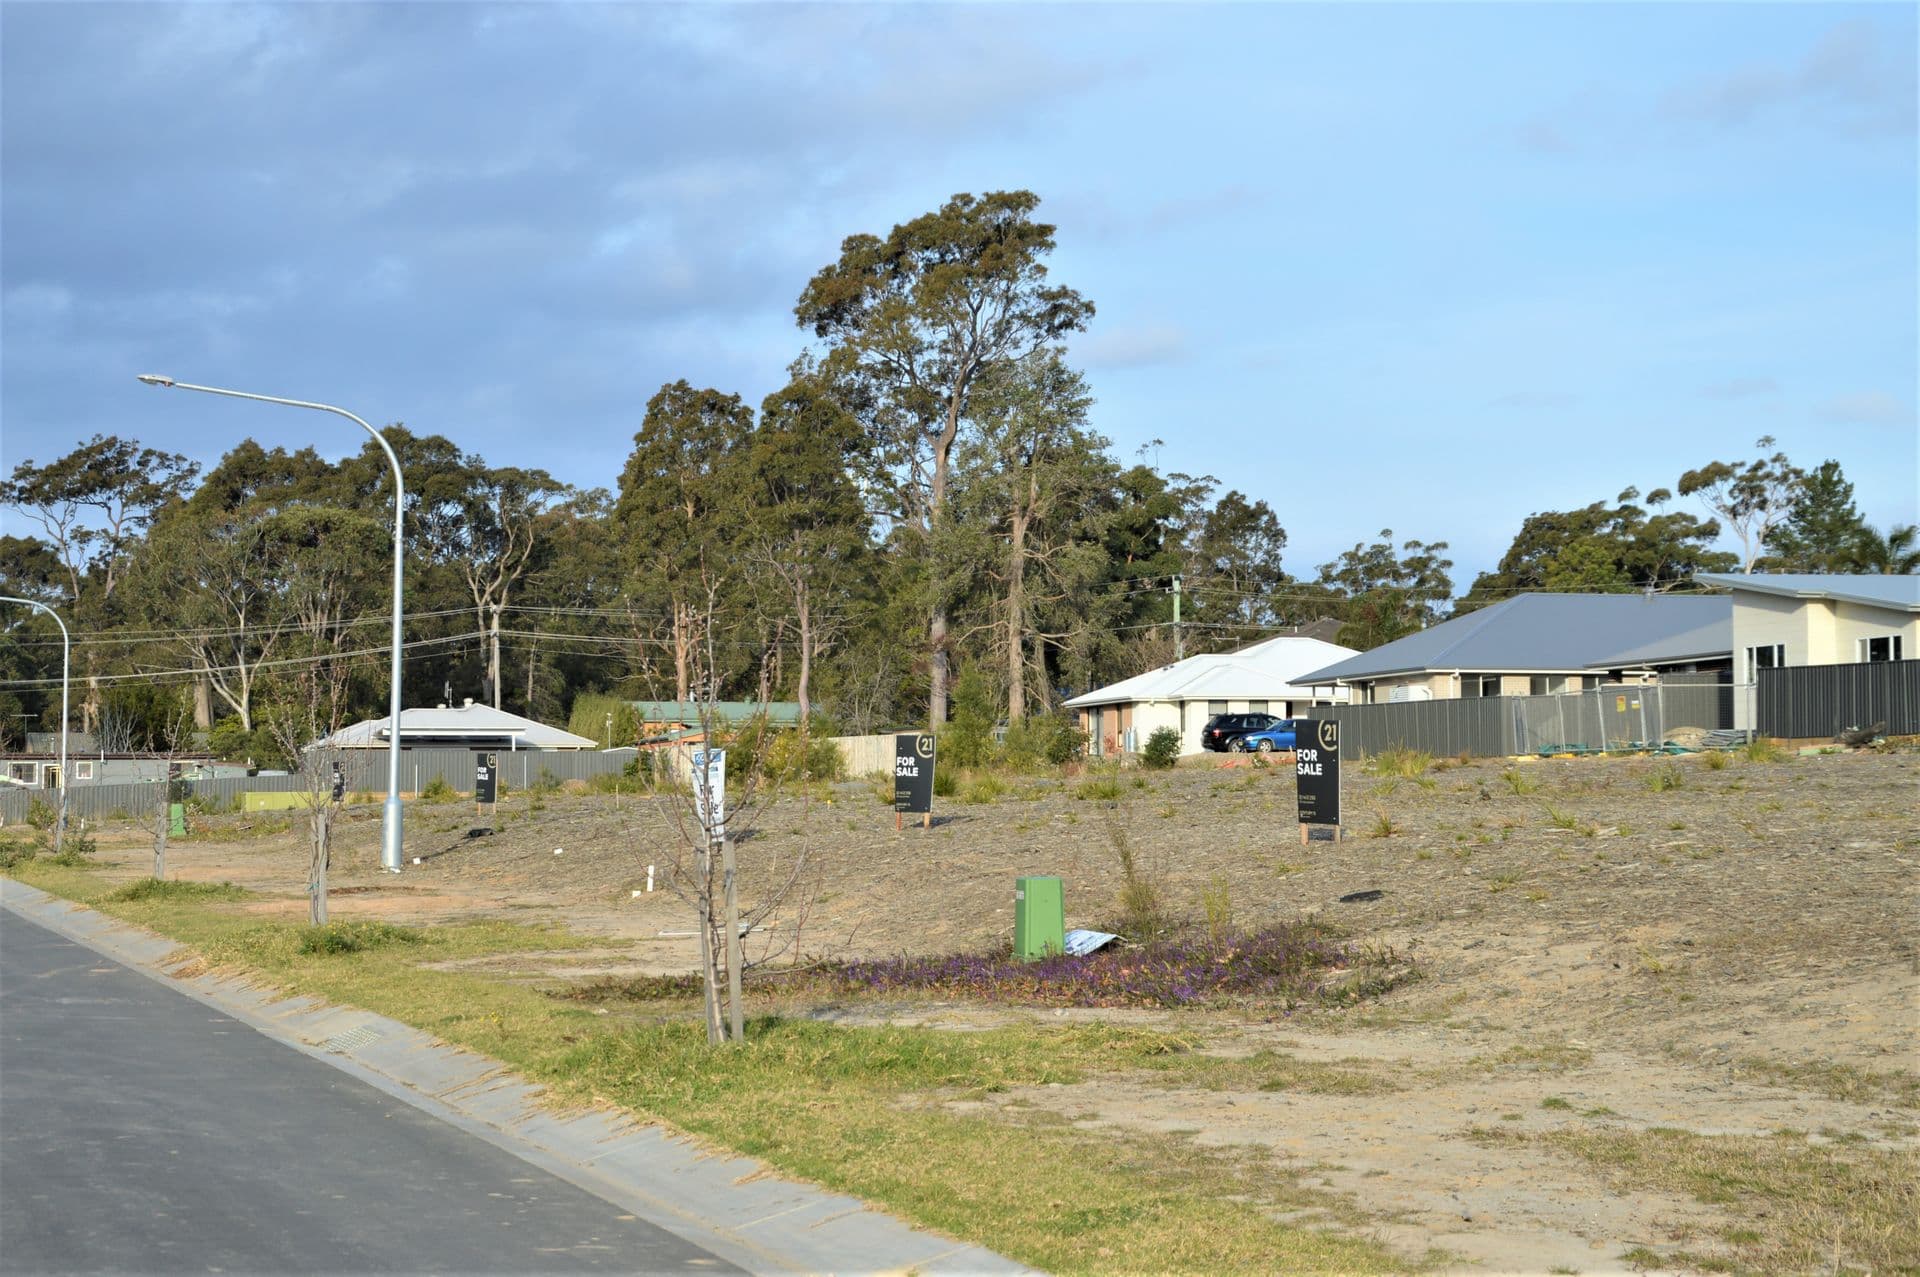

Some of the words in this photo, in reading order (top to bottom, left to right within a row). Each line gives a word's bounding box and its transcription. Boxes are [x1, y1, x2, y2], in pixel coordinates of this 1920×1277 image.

[1324, 724, 1337, 741] 21
[921, 738, 933, 751] 21
[896, 757, 915, 766] FOR
[1296, 749, 1318, 762] FOR
[896, 767, 919, 777] SALE
[1297, 763, 1323, 776] SALE
